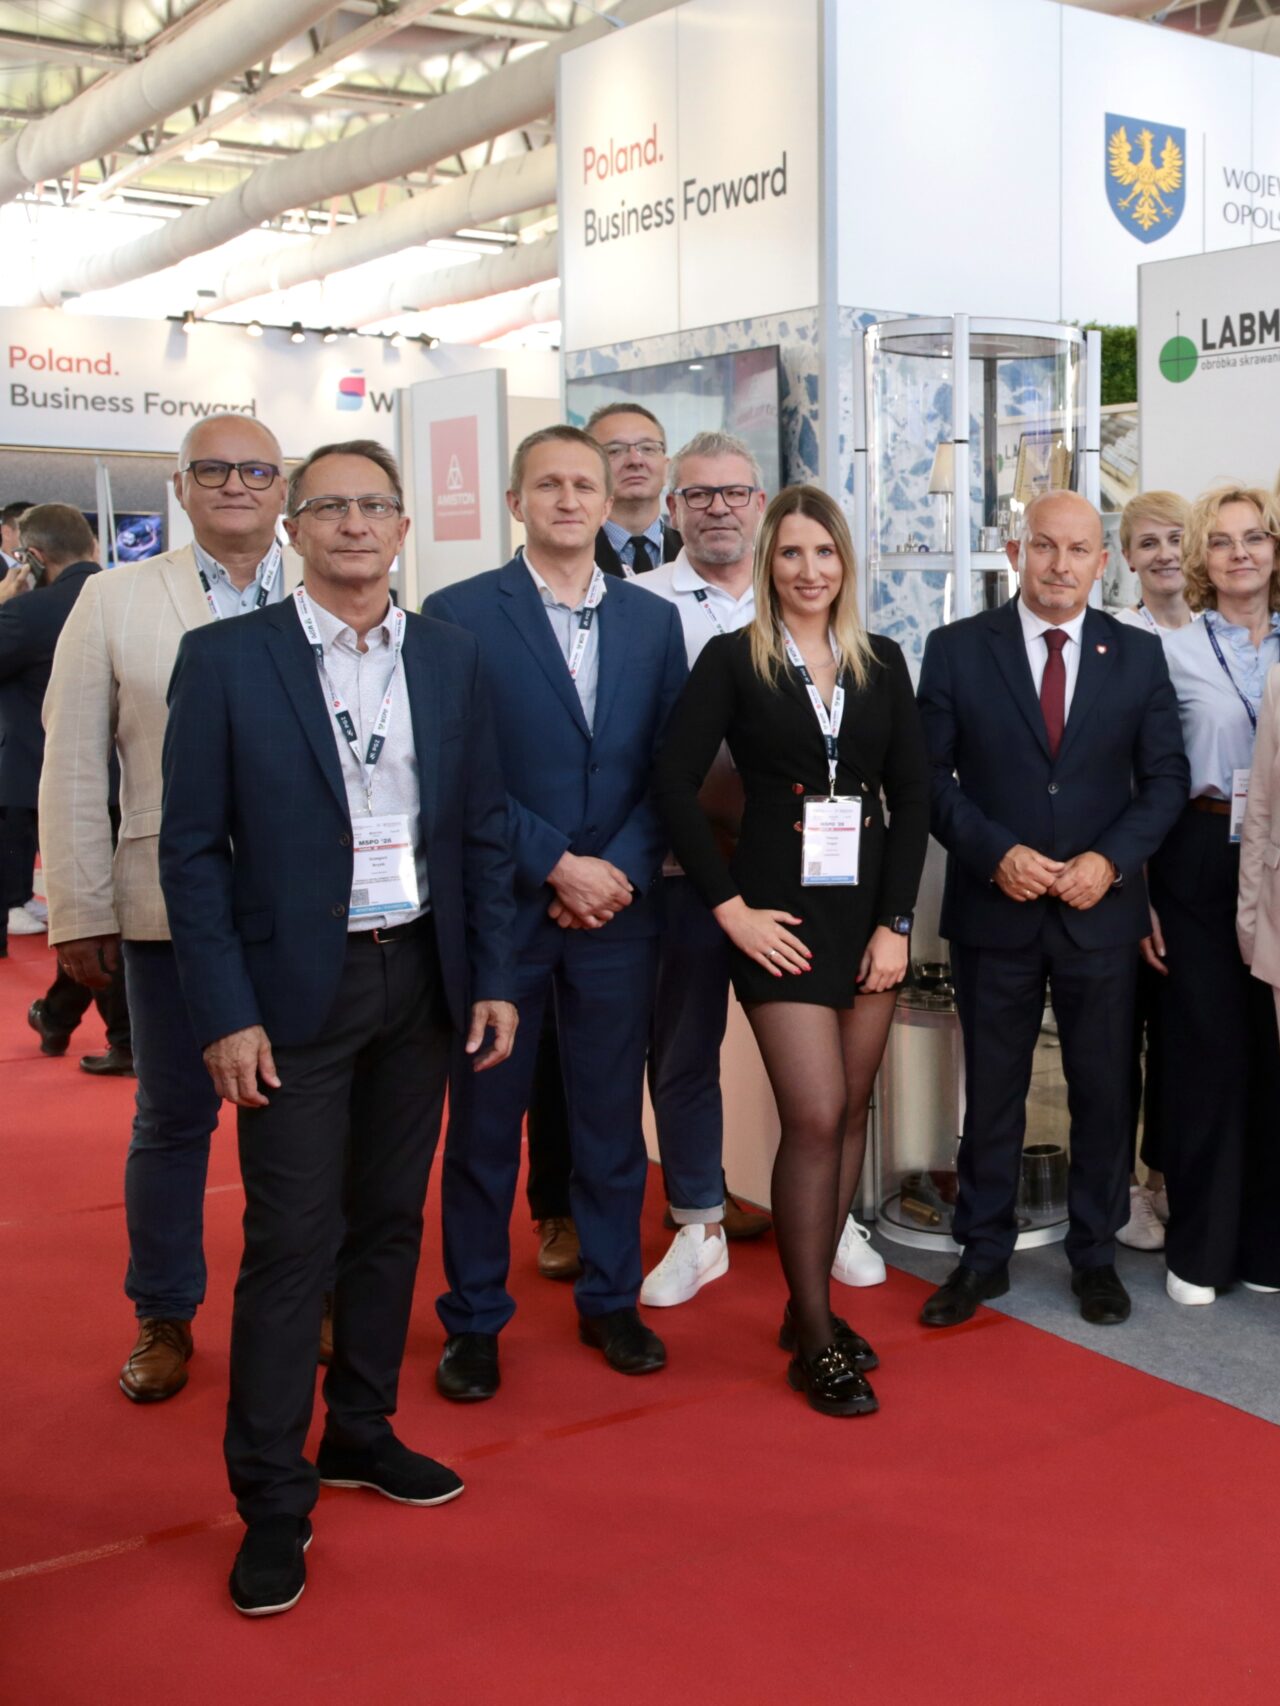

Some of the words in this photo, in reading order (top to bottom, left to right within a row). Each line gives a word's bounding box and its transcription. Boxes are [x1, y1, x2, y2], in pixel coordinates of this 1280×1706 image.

[582, 122, 664, 186] Poland.
[584, 196, 676, 248] Business
[682, 150, 788, 222] Forward
[8, 345, 120, 378] Poland.
[9, 382, 136, 414] Business
[144, 392, 256, 418] Forward
[358, 838, 380, 847] MSPO
